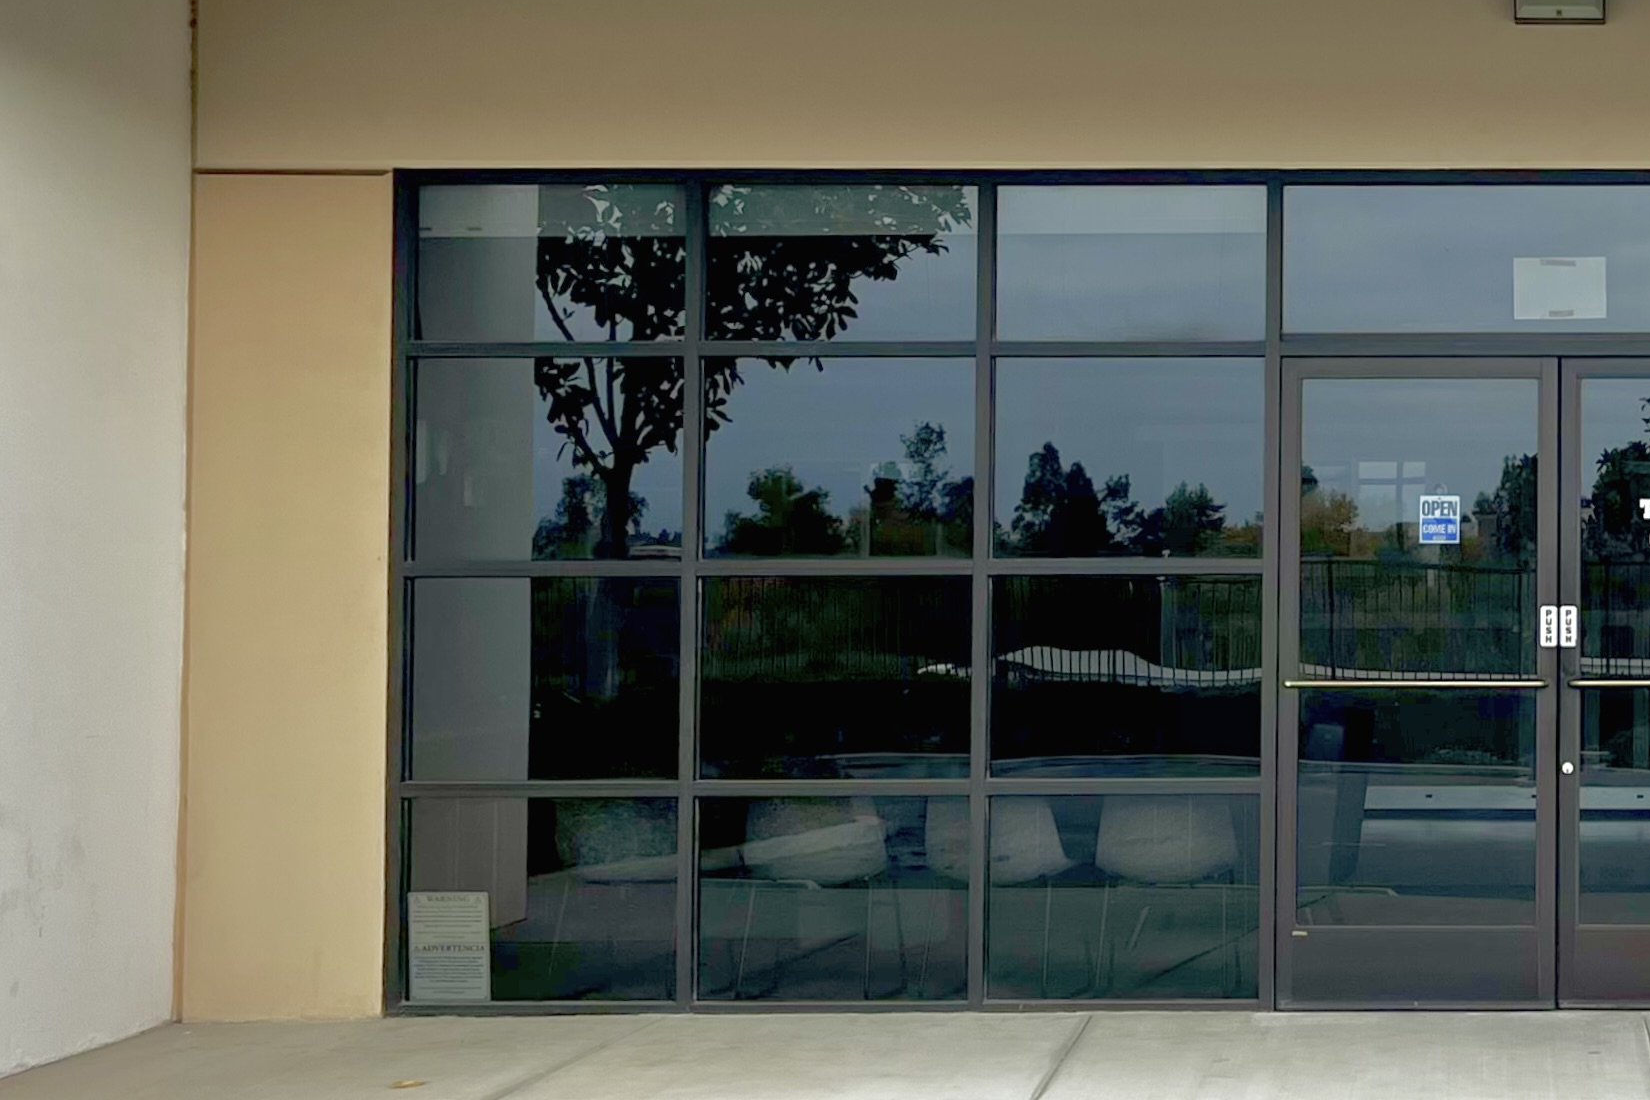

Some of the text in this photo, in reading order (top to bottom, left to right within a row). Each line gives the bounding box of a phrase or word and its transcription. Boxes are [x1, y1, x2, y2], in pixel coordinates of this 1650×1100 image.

[1422, 500, 1457, 517] OPEN
[1423, 523, 1456, 534] COME IN
[1545, 609, 1553, 644] PUSH
[1564, 609, 1573, 644] PUSH
[426, 895, 470, 903] WARNING
[422, 944, 486, 952] ADVERTENCIA
